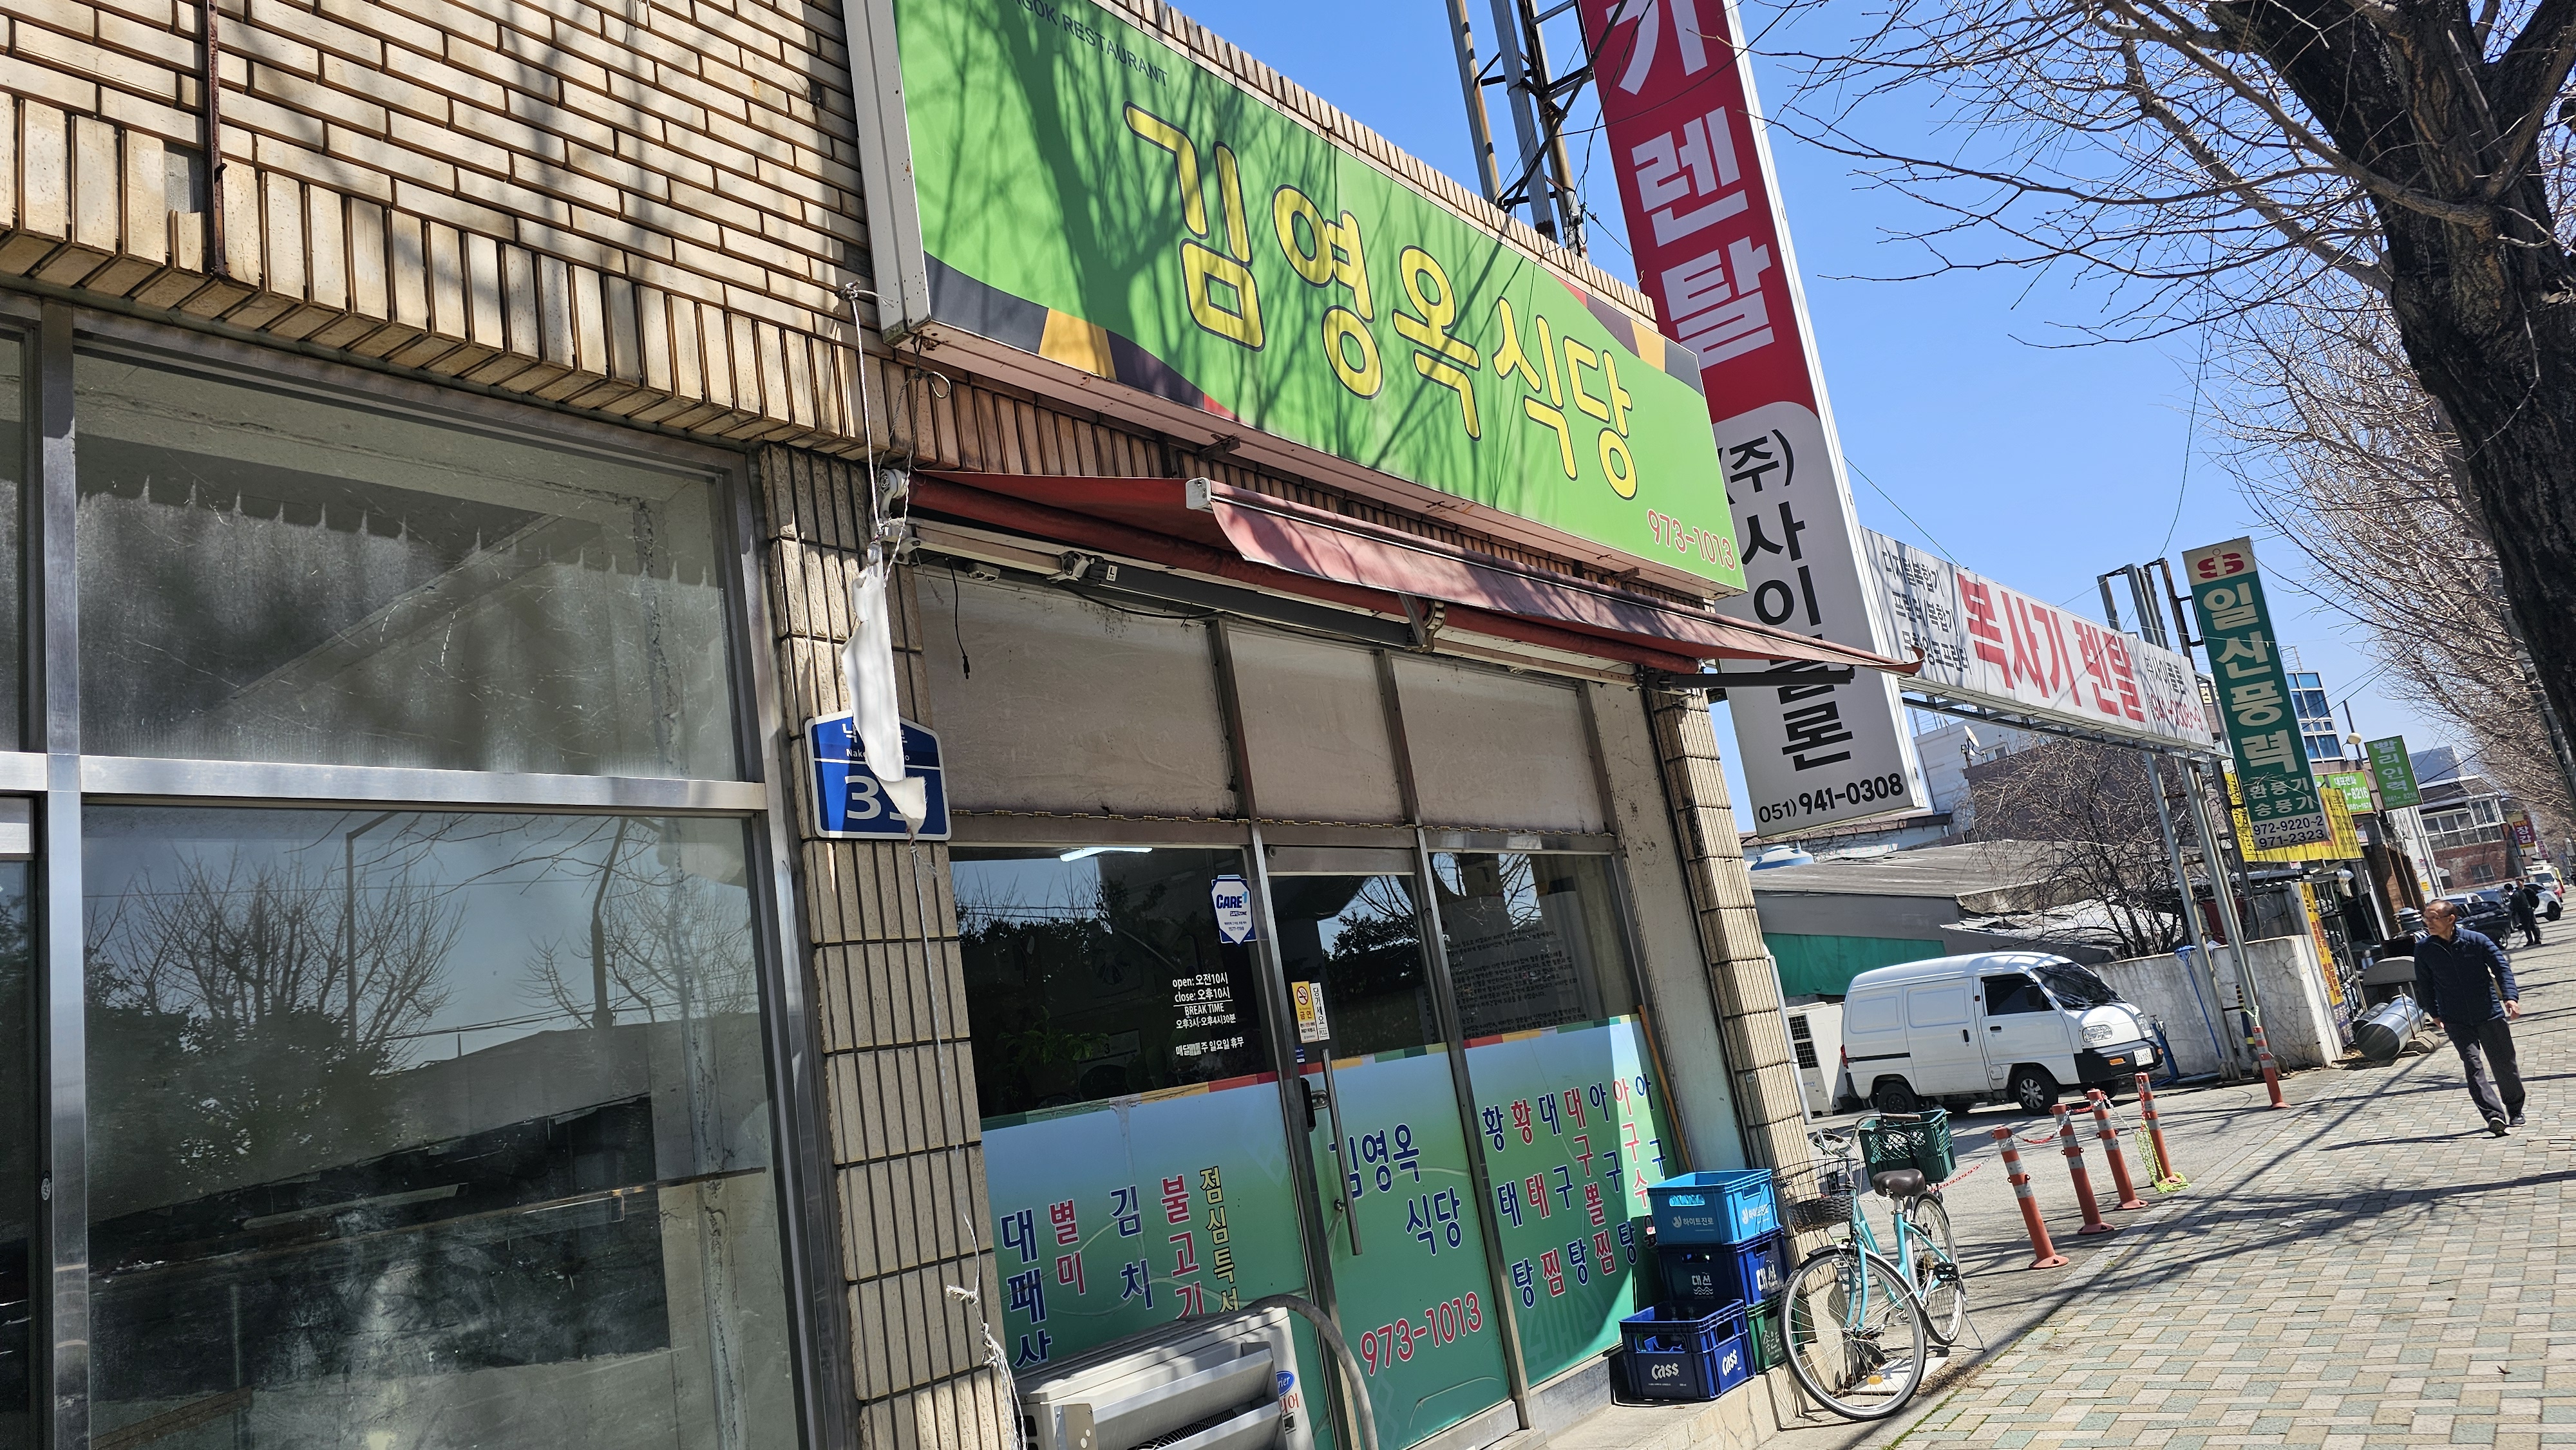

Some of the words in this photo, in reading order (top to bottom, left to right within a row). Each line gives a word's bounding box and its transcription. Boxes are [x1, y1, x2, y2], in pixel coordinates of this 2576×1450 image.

[1062, 14, 1167, 87] RESTAURANT
[1122, 100, 1638, 500] 김영옥식당
[1647, 509, 1736, 570] 973-1013
[1882, 551, 1944, 597] 디지털복합기
[1741, 502, 1853, 771] 사이론
[1956, 572, 2081, 707] 복사기
[2074, 619, 2145, 722] 렌탈
[2203, 582, 2298, 773] 일신풍력
[1759, 798, 1797, 824] 051)
[1799, 773, 1904, 815] 941-0308
[2255, 796, 2315, 816] 송풍기
[2343, 787, 2370, 801] 1-8216
[2253, 816, 2324, 835] 972-9220~2
[2259, 829, 2325, 847] 971-2323
[1173, 978, 1195, 990] open:
[1195, 972, 1228, 985] 오전10시
[1175, 992, 1197, 1003] close:
[1198, 986, 1230, 1000] 오후10시
[1184, 1004, 1208, 1016] BREAK
[1208, 1003, 1224, 1013] TIME
[1313, 987, 1325, 1024] 당기세요
[1209, 1038, 1230, 1052] 일요일
[1231, 1037, 1244, 1048] 휴무
[1564, 1087, 1616, 1276] 대구뽈찜
[1406, 1186, 1463, 1256] 식당
[1683, 1217, 1714, 1225] 하이트진로
[1049, 1199, 1086, 1295] 별미
[1161, 1174, 1206, 1319] 불고기
[1692, 1274, 1712, 1285] 대선
[1360, 1292, 1482, 1377] 973-1013
[1651, 1363, 1679, 1380] Cass
[1722, 1349, 1738, 1376] Cass
